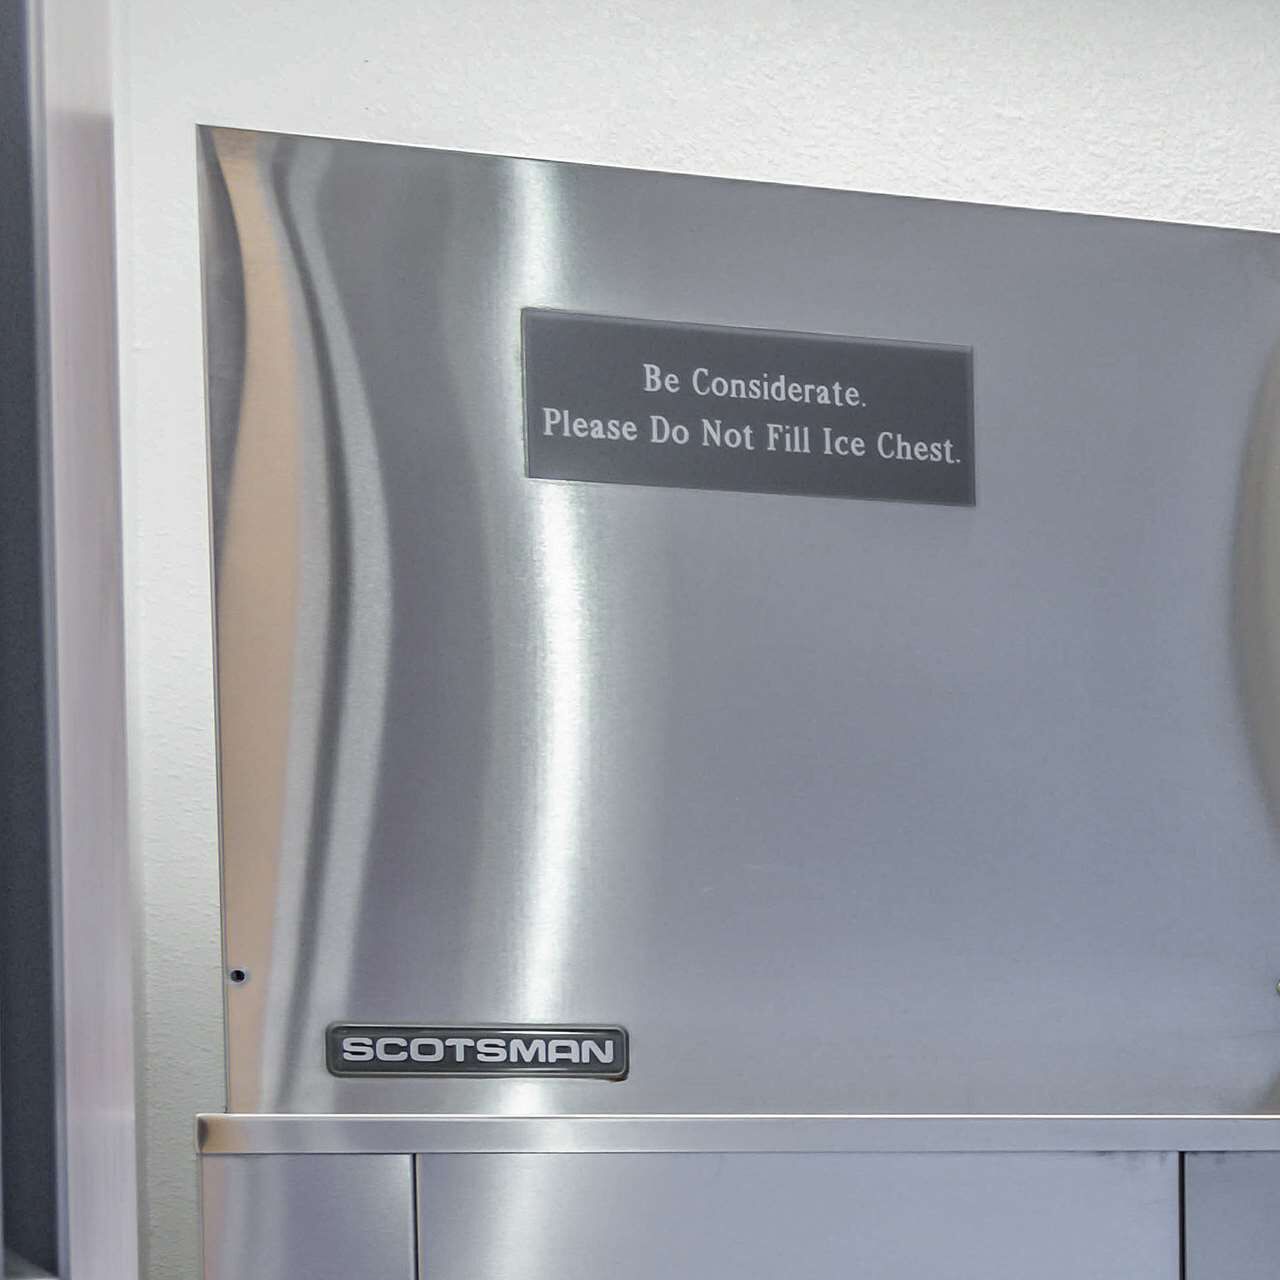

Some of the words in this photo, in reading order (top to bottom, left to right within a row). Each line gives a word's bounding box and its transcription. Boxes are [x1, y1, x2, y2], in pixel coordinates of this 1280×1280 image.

[642, 363, 681, 393] Be
[692, 367, 867, 408] Considerate.
[542, 407, 638, 442] Please
[649, 414, 690, 446] Do
[701, 417, 756, 452] Not
[766, 423, 811, 454] Fill
[822, 427, 866, 457] Ice
[876, 431, 962, 465] Chest.
[341, 1036, 614, 1064] SCOTSMAN
